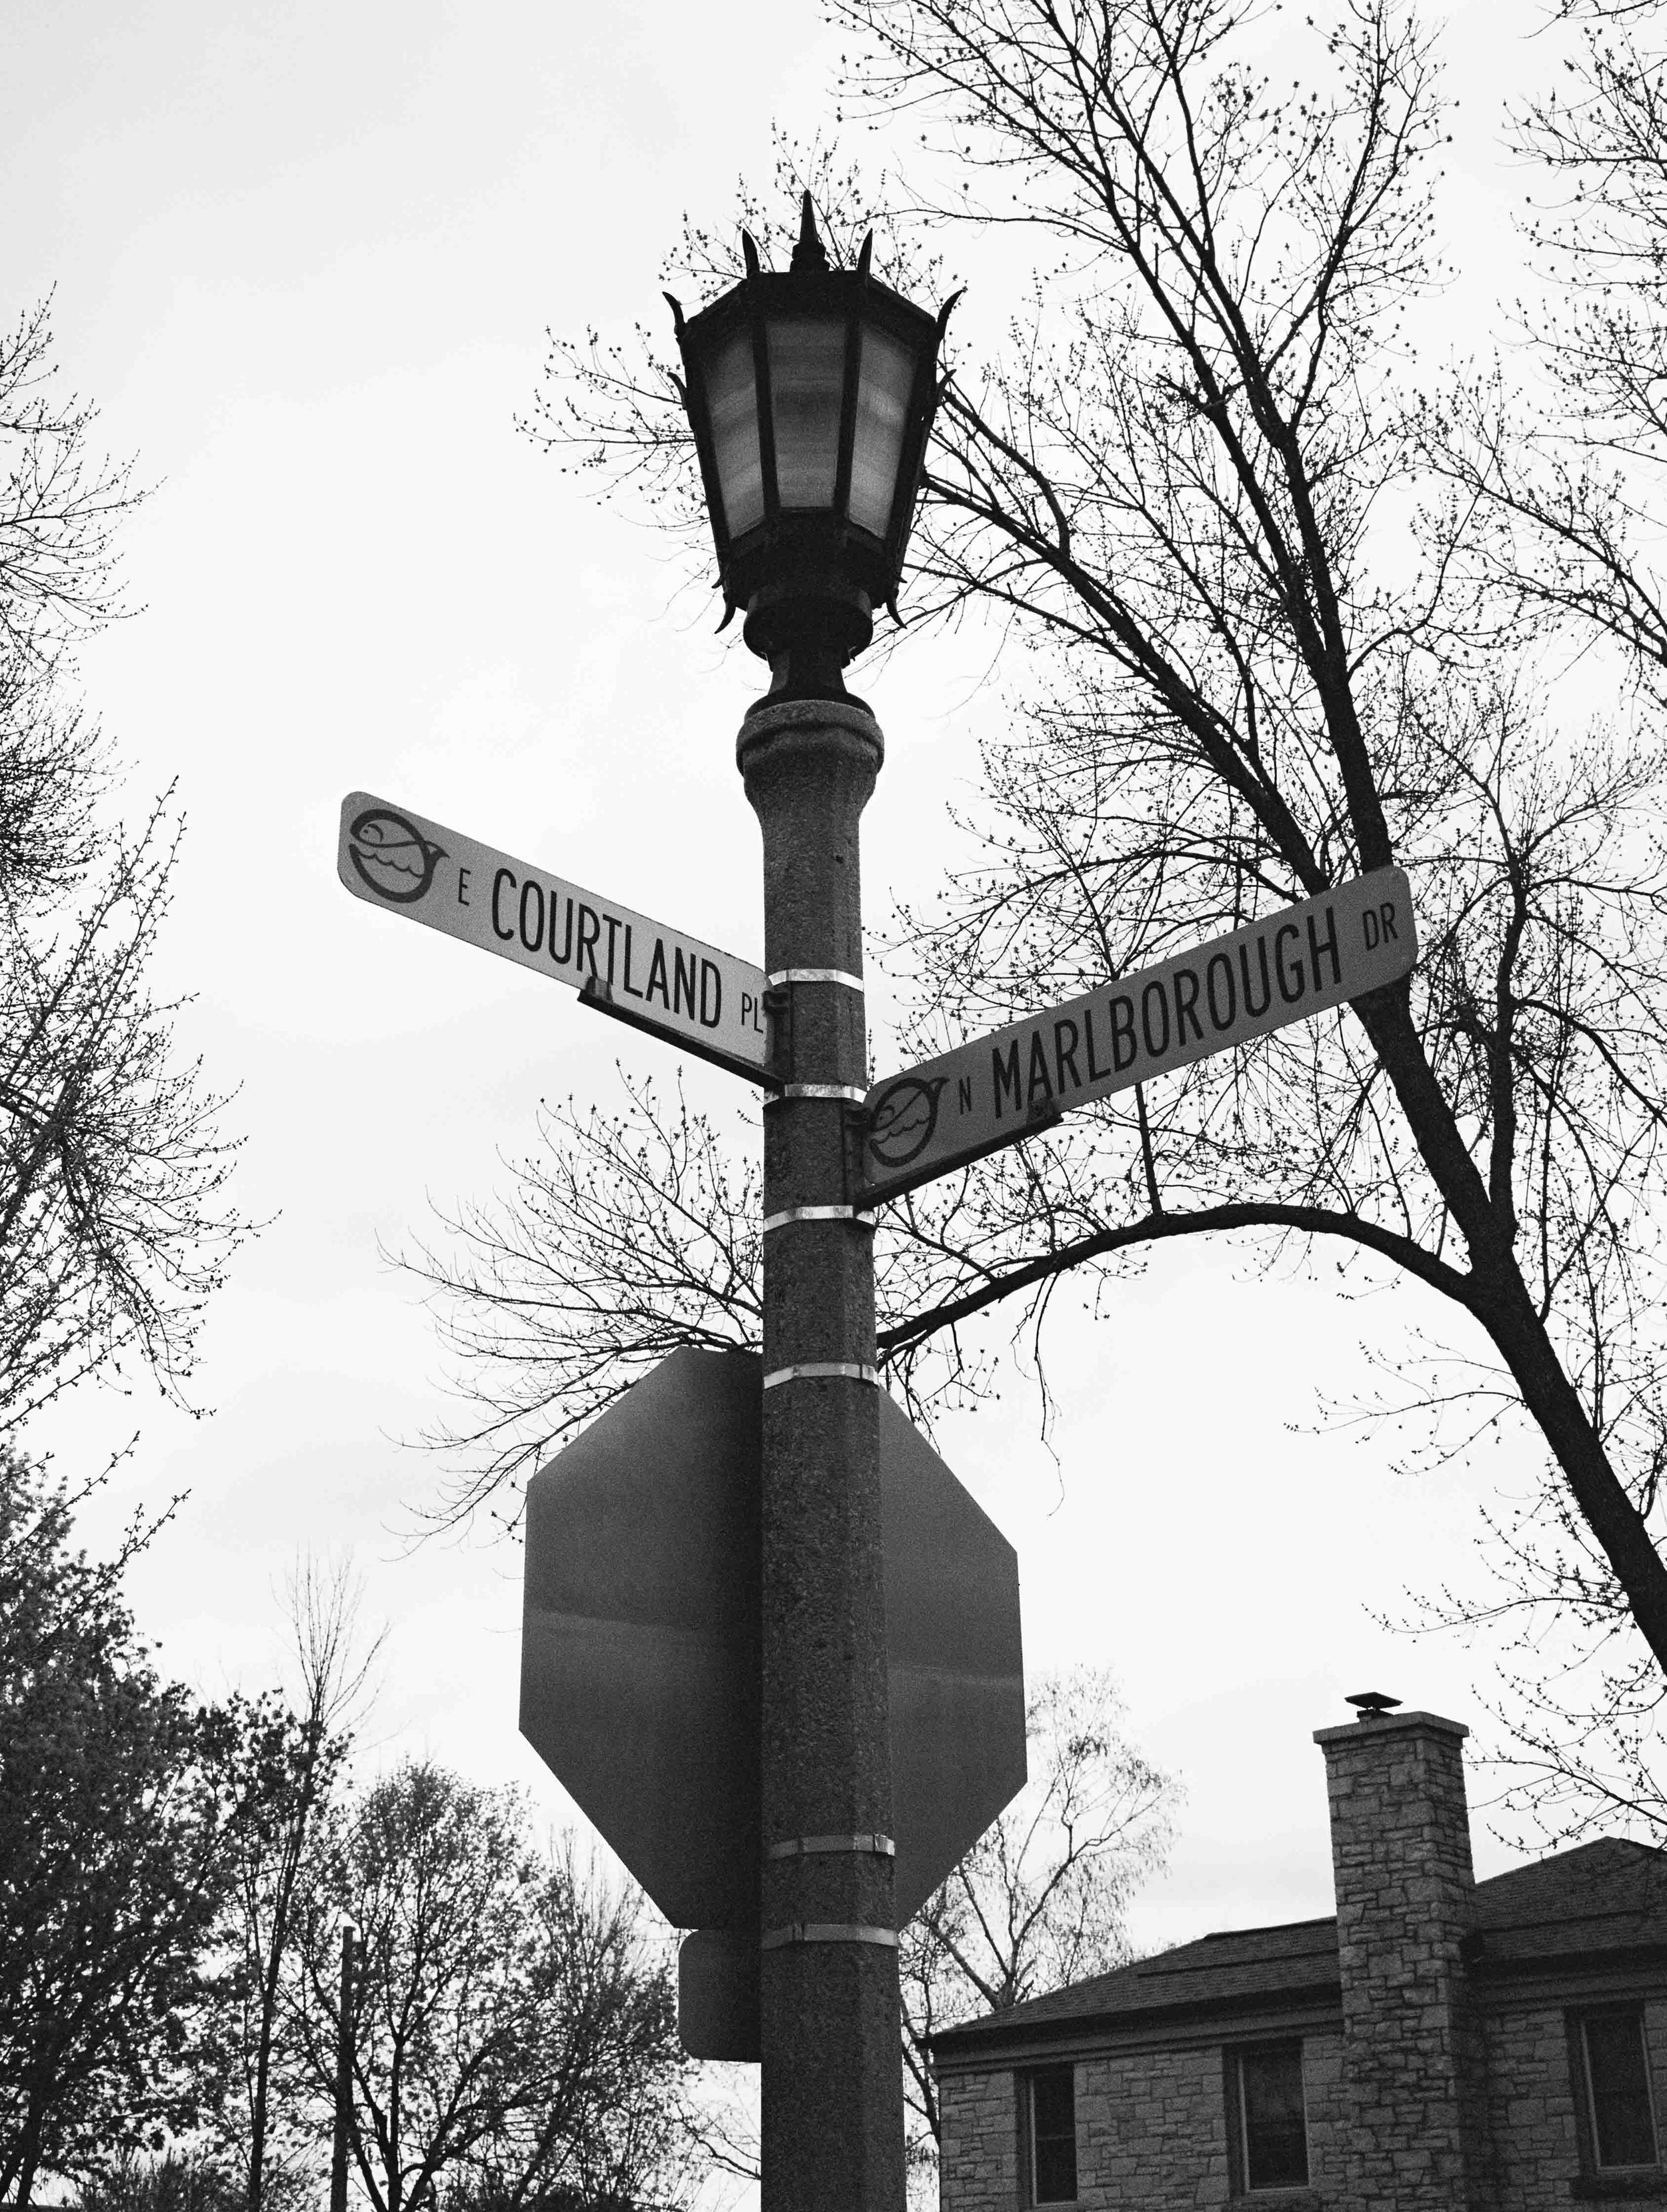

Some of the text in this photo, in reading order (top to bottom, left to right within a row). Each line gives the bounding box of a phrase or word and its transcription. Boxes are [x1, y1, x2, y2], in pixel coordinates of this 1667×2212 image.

[458, 868, 763, 1034] E COURTLAND PL
[959, 902, 1398, 1118] N MARLBOROUGH DR
